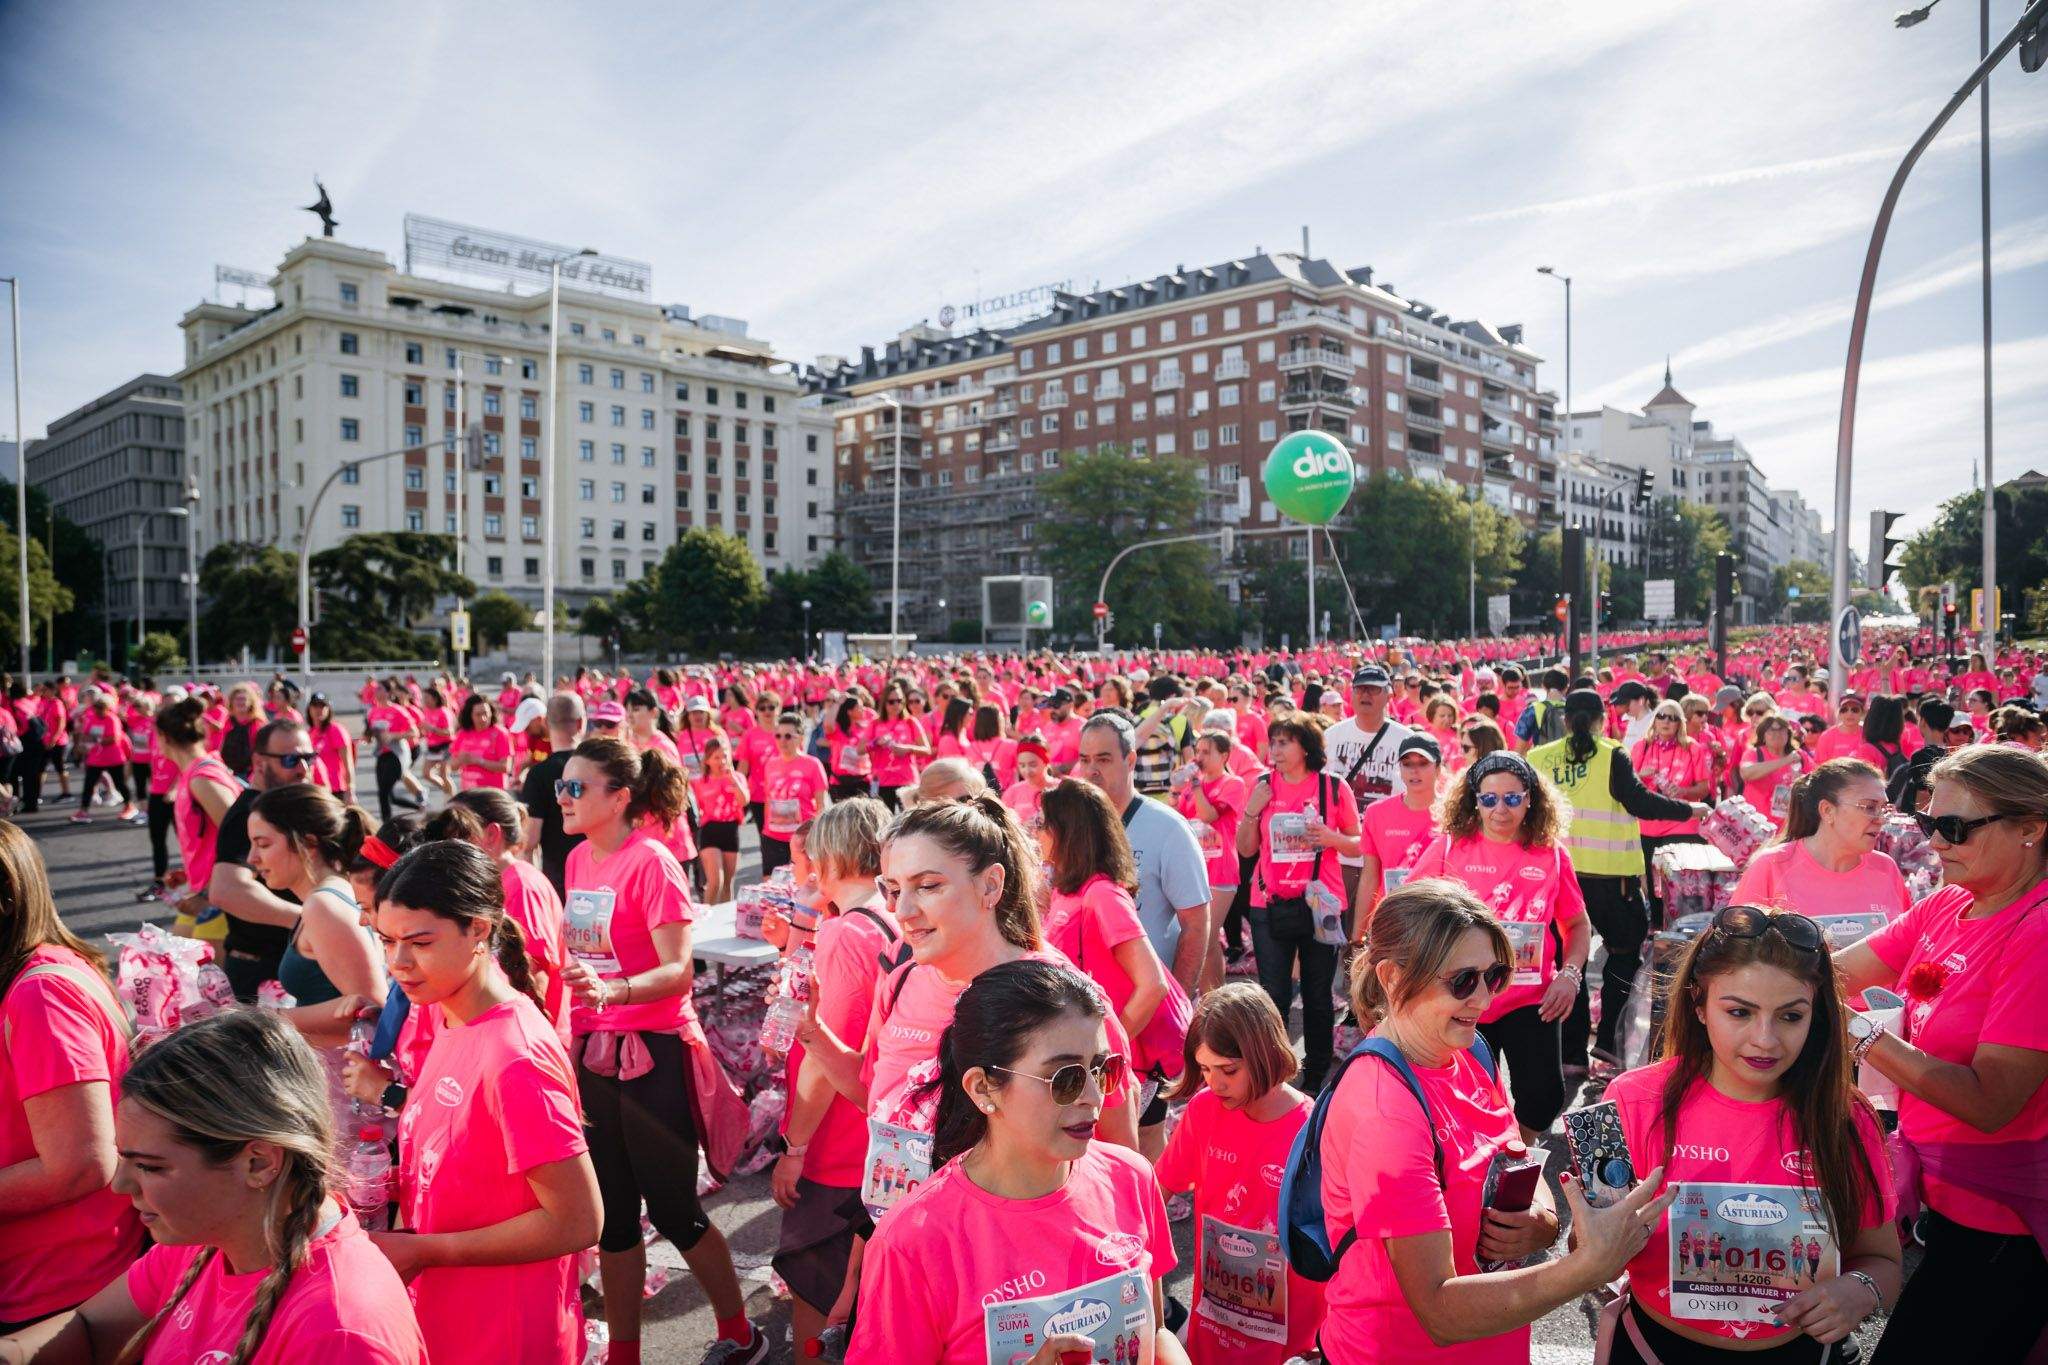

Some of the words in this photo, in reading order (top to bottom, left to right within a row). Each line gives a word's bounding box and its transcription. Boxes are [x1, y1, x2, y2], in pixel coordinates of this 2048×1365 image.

[452, 236, 508, 265] Gran
[517, 250, 582, 279] Meiá
[1465, 864, 1497, 874] OYSHO
[1680, 1196, 1705, 1205] SUMA
[1722, 1204, 1784, 1219] ASTURIANA
[1725, 1247, 1786, 1271] 016
[1735, 1274, 1771, 1285] 14206
[1689, 1283, 1725, 1293] CARRERA
[1740, 1286, 1750, 1294] LA
[1751, 1287, 1779, 1297] MUJER
[1688, 1299, 1738, 1312] OYSHO
[998, 1318, 1030, 1331] SUMA
[1049, 1309, 1108, 1338] ASTURIANA
